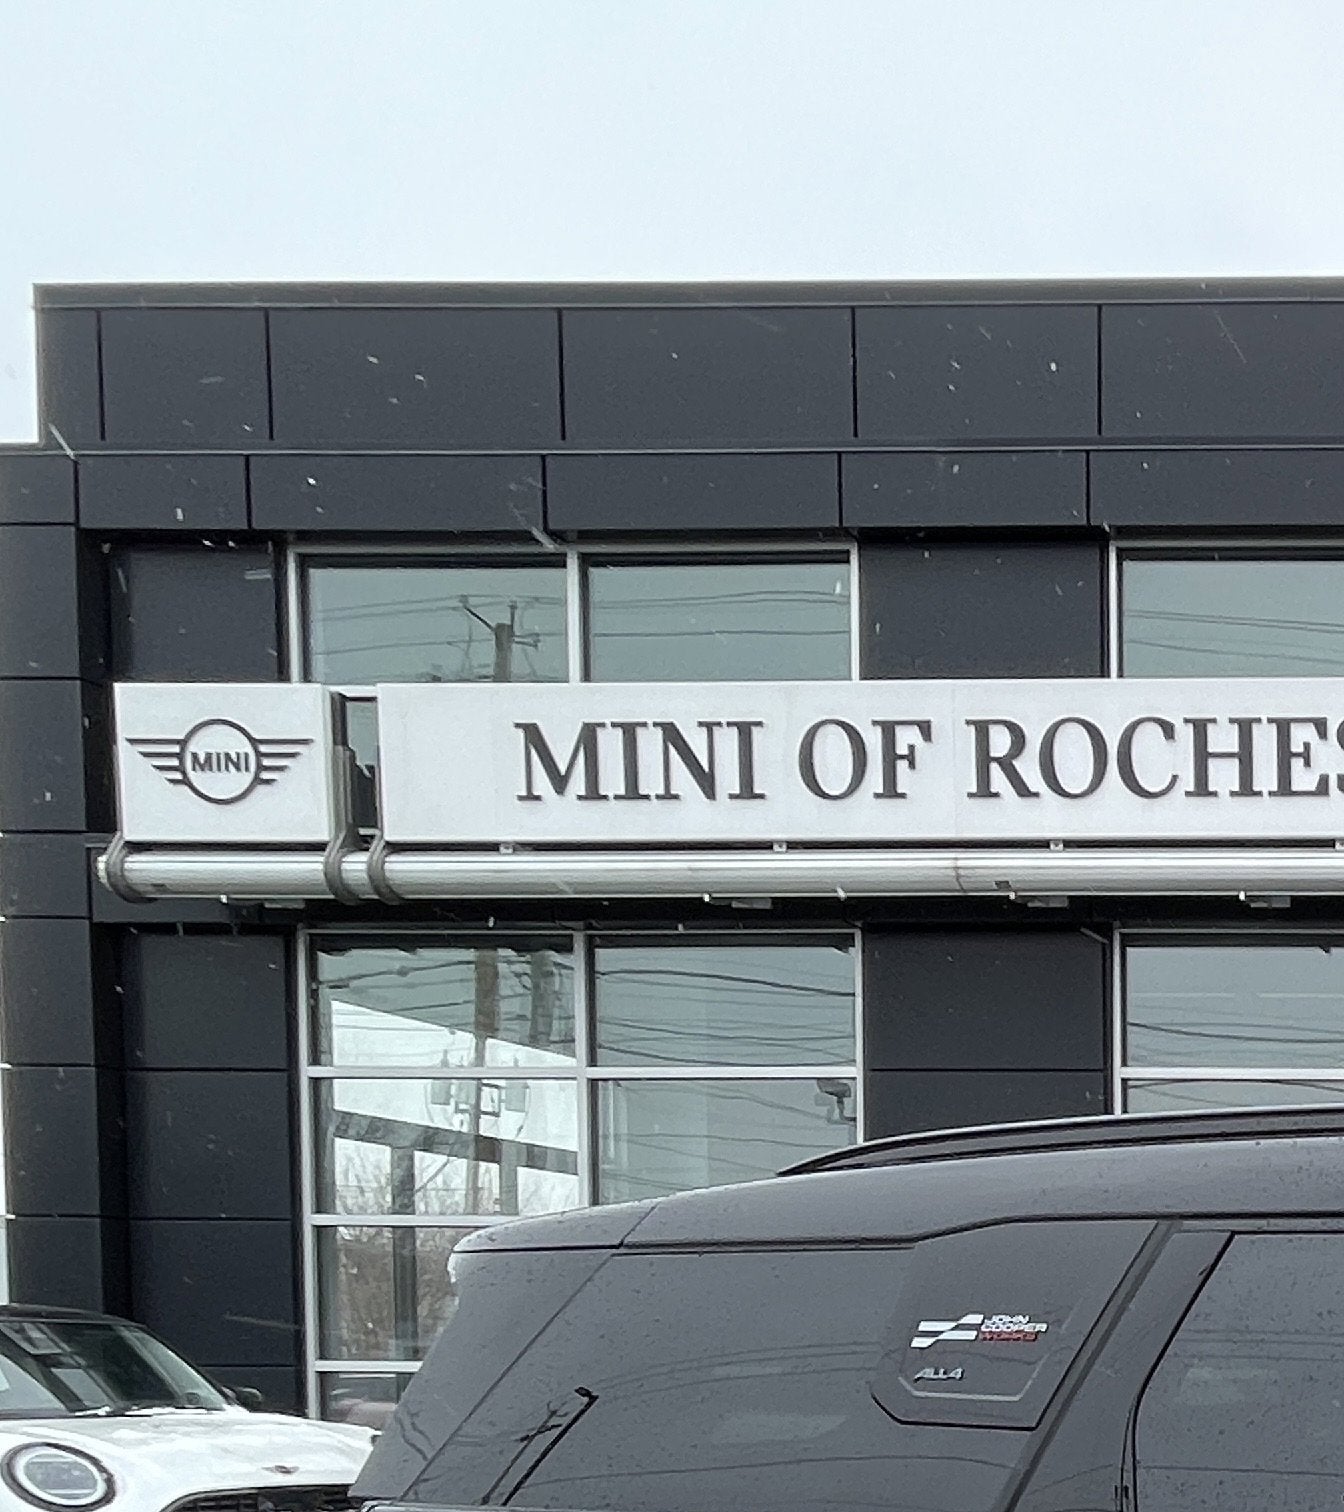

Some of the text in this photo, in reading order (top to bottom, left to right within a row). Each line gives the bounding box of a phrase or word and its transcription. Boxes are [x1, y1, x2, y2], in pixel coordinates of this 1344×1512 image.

[190, 751, 250, 773] MINI
[513, 719, 766, 801] MINI
[798, 717, 932, 800] OF
